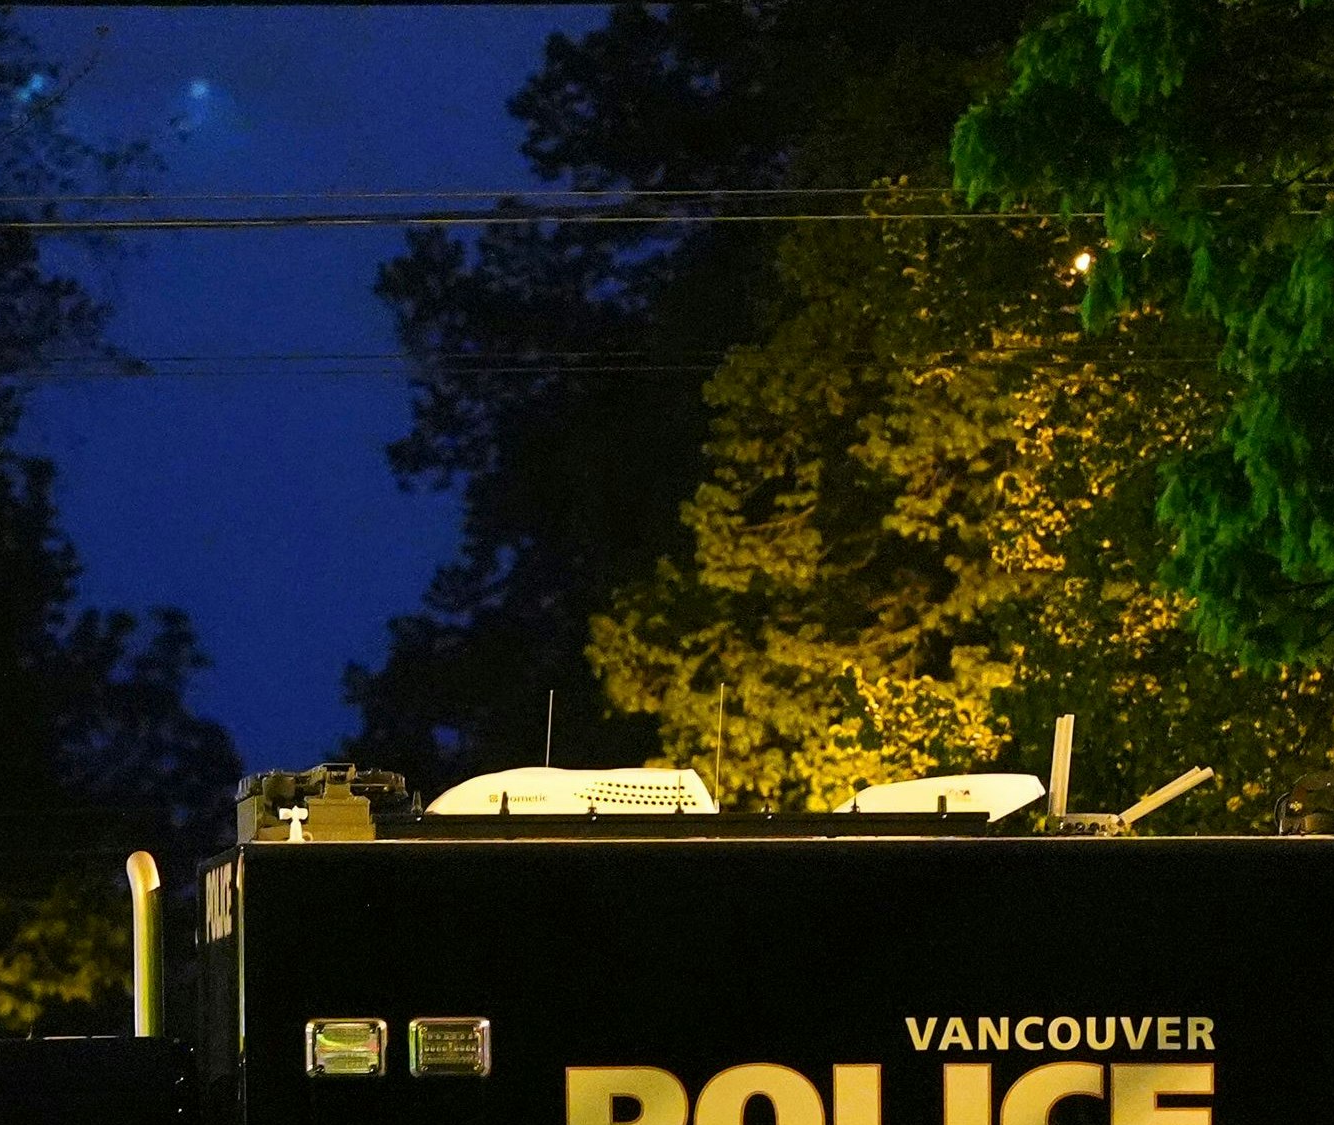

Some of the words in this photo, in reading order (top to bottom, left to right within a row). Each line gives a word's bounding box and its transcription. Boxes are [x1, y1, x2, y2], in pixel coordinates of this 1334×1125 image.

[508, 794, 548, 803] ometic
[206, 862, 232, 944] POLICE
[905, 1016, 1216, 1051] VANCOUVER
